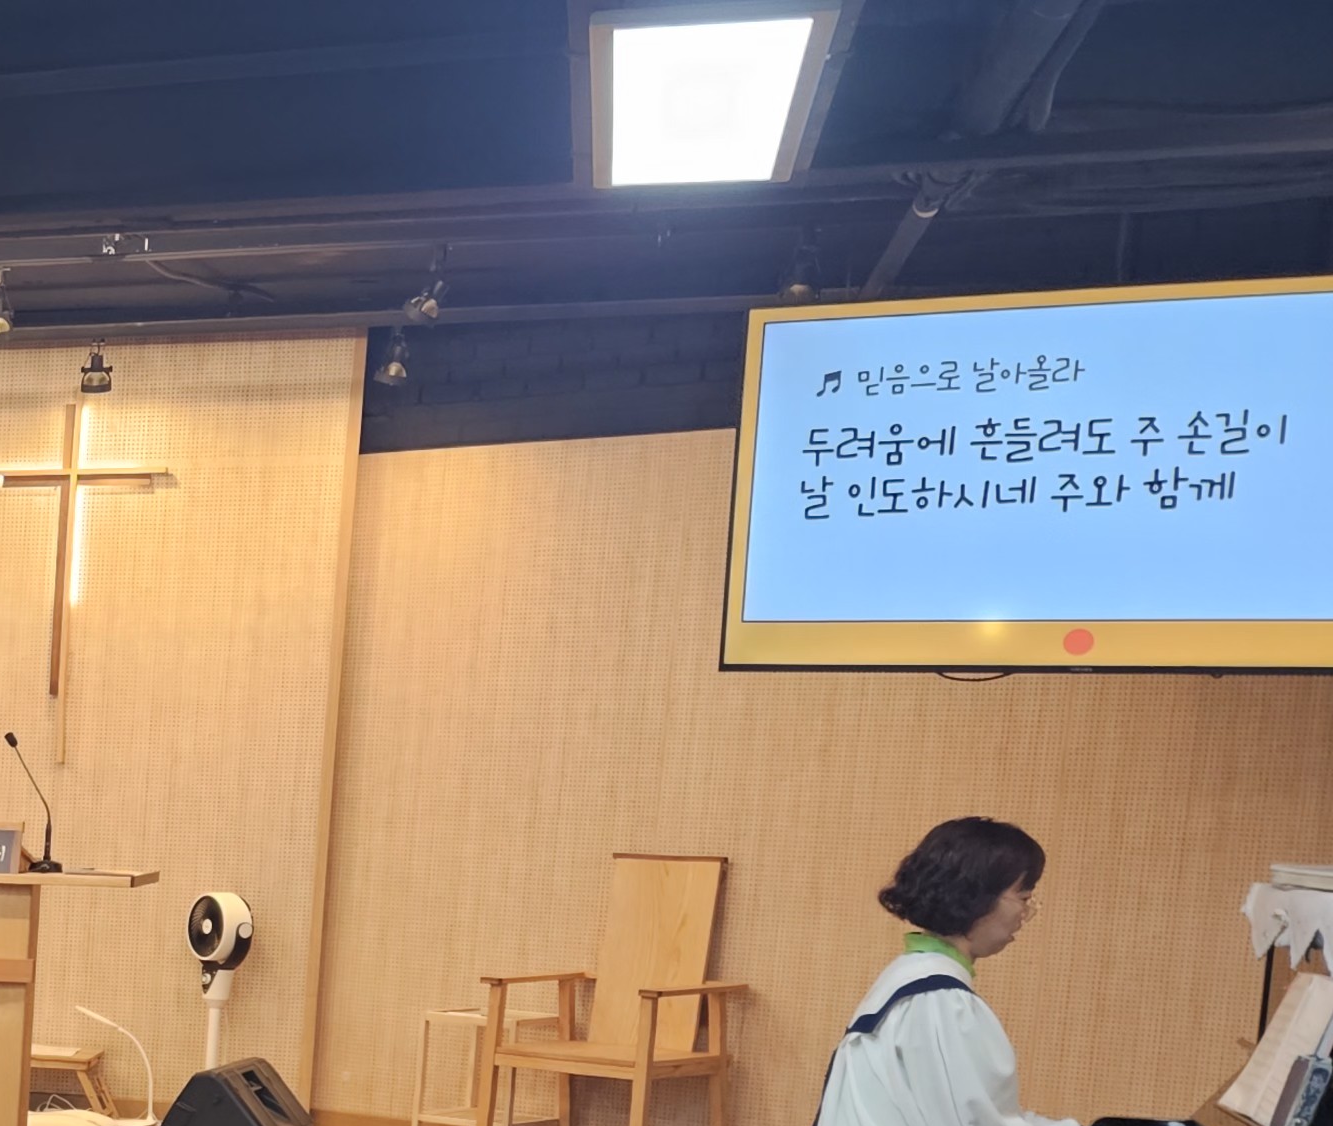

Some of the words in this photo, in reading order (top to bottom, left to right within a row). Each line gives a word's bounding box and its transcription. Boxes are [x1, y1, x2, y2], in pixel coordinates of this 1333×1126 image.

[857, 360, 962, 398] 믿음으로
[972, 354, 1087, 394] 날아올라
[801, 422, 958, 467] 두려움에
[969, 416, 1117, 464] 흔들려도
[1130, 416, 1165, 457] 주
[1177, 408, 1289, 456] 손길이
[800, 475, 835, 521] 날
[847, 474, 1037, 518] 인도하시네
[1050, 472, 1132, 513] 주와
[1142, 465, 1237, 510] 함께
